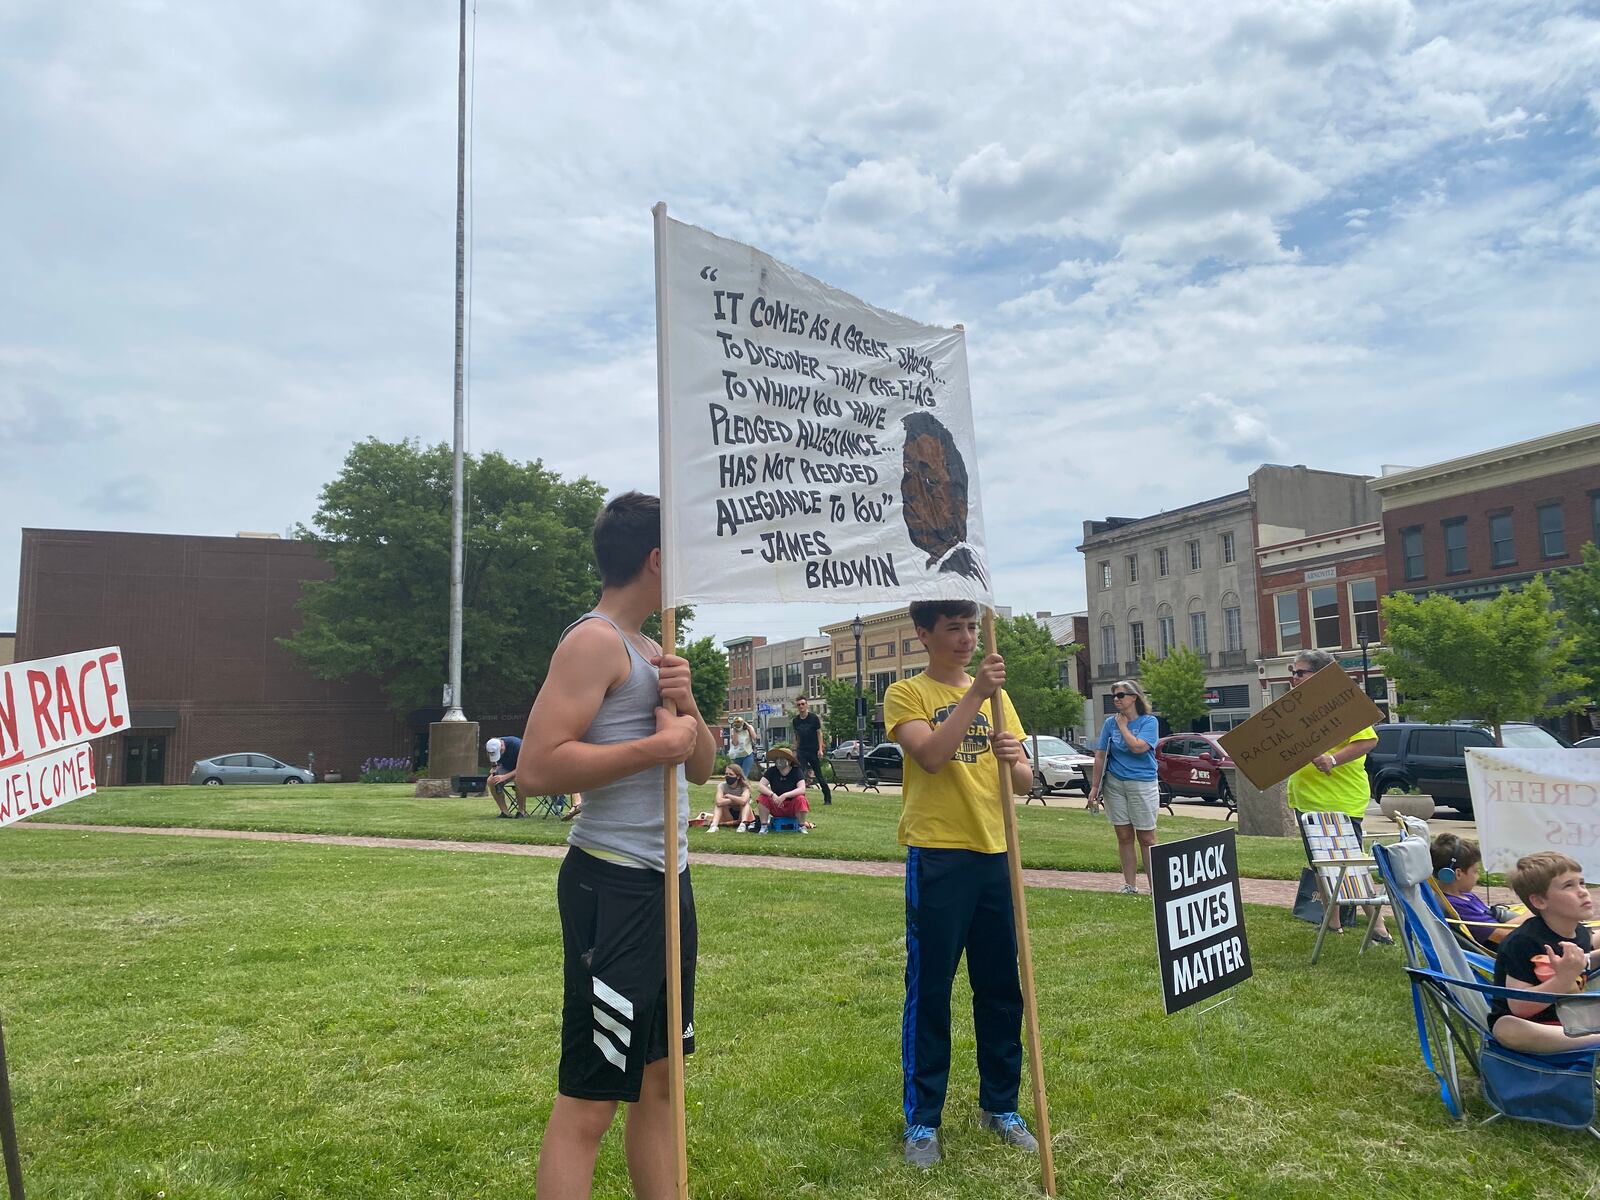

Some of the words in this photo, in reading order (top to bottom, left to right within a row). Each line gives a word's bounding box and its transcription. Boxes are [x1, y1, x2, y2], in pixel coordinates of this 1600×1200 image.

[714, 291, 744, 324] IT
[750, 297, 808, 335] COMES
[809, 314, 830, 341] AS
[831, 323, 841, 349] A
[844, 324, 892, 362] GREAT
[744, 338, 826, 381] DISCOVER
[827, 365, 867, 394] THAT
[869, 377, 899, 396] THE
[897, 380, 936, 407] FLAG
[709, 403, 793, 445] PLEDGED
[747, 376, 810, 413] WHICH
[813, 390, 842, 417] YOU
[846, 400, 886, 430] HAVE
[719, 454, 757, 488] HAS
[763, 453, 795, 484] NOT
[800, 459, 878, 485] PLEDGED
[716, 490, 822, 536] ALLEGIANCE
[760, 531, 832, 563] JAMES
[806, 553, 900, 588] BALDWIN
[27, 653, 123, 749] RACE
[1261, 691, 1303, 729] STOP
[1240, 729, 1295, 765] RACIAL
[1300, 687, 1355, 729] INEQUALITY
[1190, 768, 1198, 780] 2
[1169, 844, 1228, 891] BLACK
[1176, 891, 1229, 940] LIVES
[1173, 936, 1245, 996] MATTER
